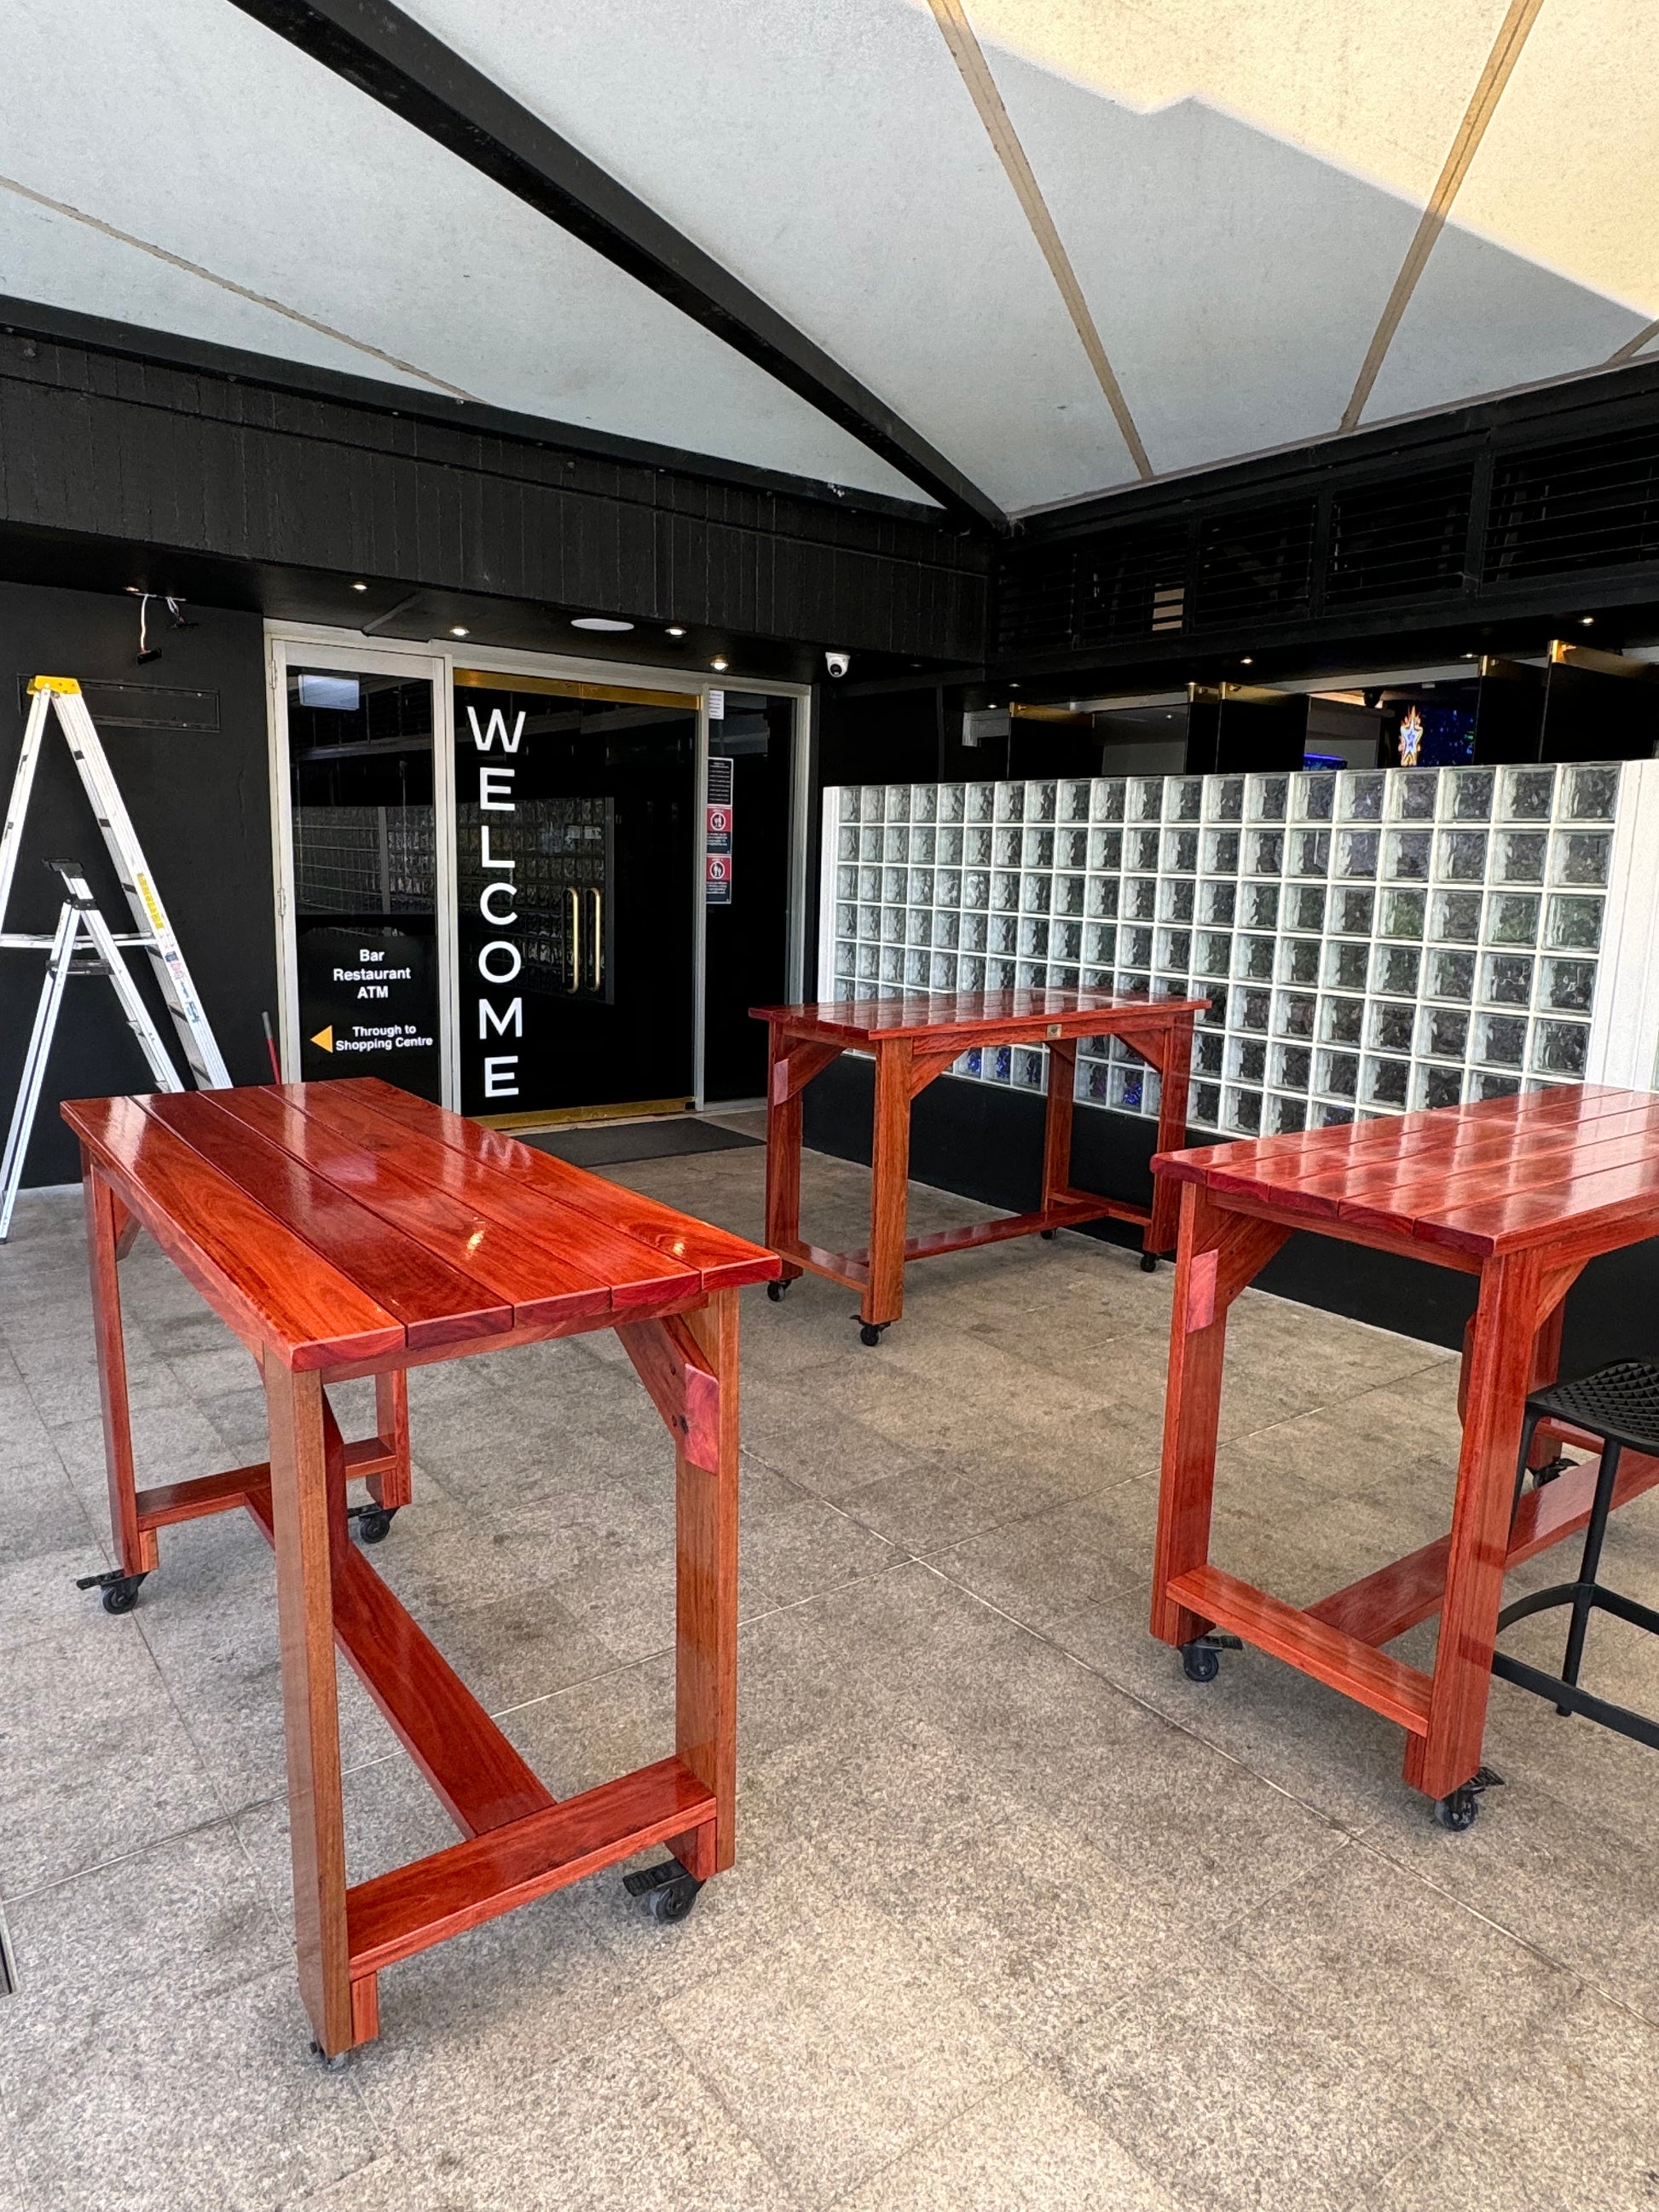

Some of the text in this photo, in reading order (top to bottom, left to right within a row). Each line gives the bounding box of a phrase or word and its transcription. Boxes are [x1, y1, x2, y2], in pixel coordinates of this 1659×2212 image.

[467, 706, 526, 1098] WELCOME
[359, 949, 384, 962] Bar
[333, 967, 411, 981] Restaurant
[356, 985, 389, 999] ATM
[352, 1025, 416, 1037] Through to
[335, 1037, 433, 1052] Shopping Centre
